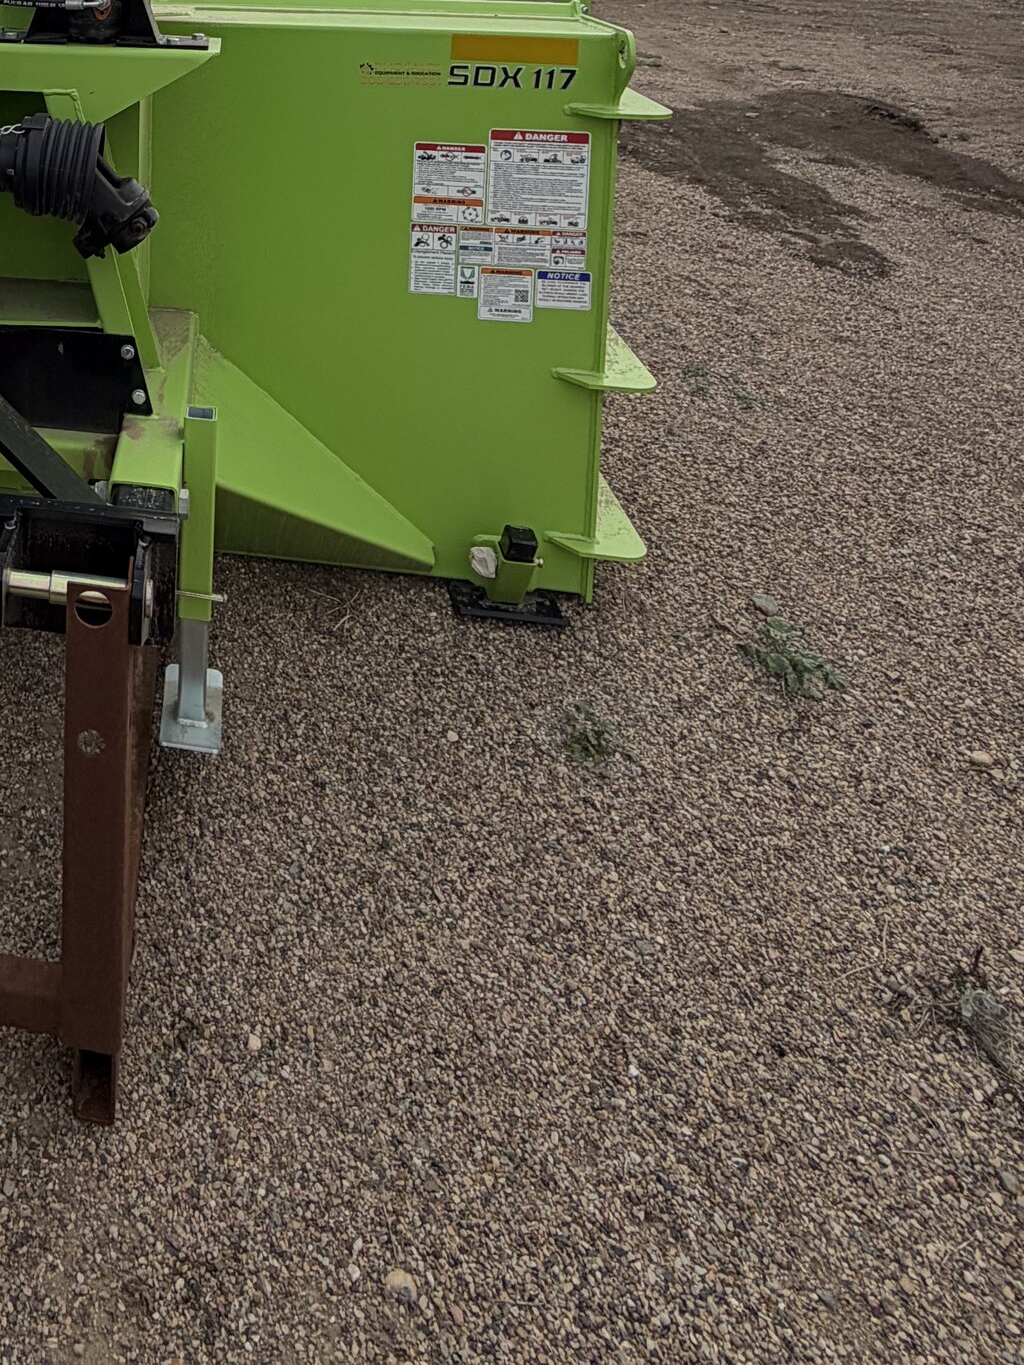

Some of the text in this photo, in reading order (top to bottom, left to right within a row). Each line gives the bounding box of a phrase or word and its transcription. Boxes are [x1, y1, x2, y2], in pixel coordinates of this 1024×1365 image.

[447, 65, 524, 89] SDX
[533, 68, 578, 90] 117
[525, 133, 568, 142] DANGER
[422, 224, 456, 233] DANGER
[547, 273, 581, 281] NOTICE
